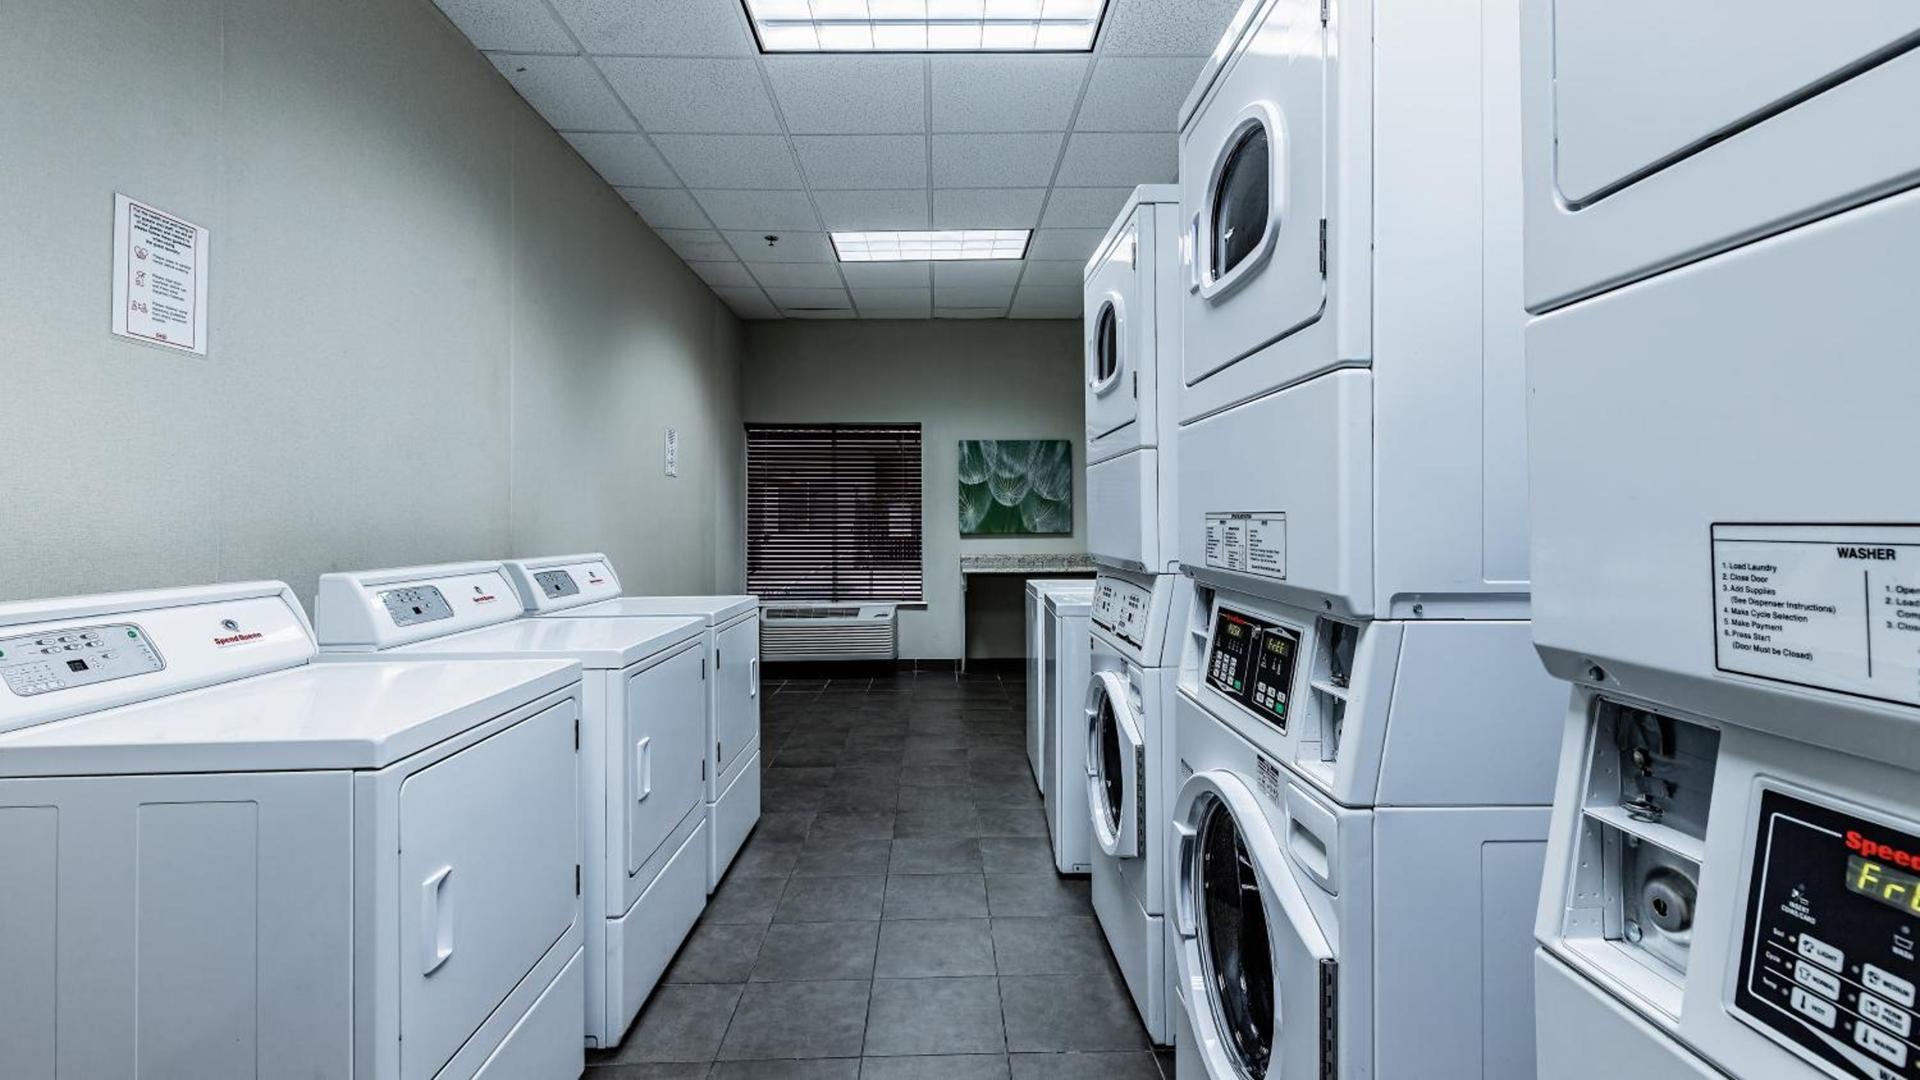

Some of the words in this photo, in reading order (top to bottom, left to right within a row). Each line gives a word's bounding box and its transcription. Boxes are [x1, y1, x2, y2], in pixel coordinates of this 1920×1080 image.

[1837, 547, 1896, 560] WASHER
[1729, 562, 1746, 570] Load
[1747, 563, 1777, 573] Laundry
[1730, 573, 1749, 582] Close
[1750, 574, 1768, 583] Door
[1730, 584, 1744, 593] Add
[1745, 585, 1776, 596] Supplies
[1730, 596, 1746, 605] (See
[1748, 597, 1785, 608] Dispenser
[1786, 600, 1837, 615] Instructions)
[1731, 607, 1749, 616] Make
[1750, 609, 1771, 619] Cycle
[1772, 611, 1808, 623] Selection
[1731, 618, 1750, 628] Make
[1751, 620, 1783, 632] Payment
[1731, 630, 1751, 640] Press
[1753, 633, 1771, 642] Start
[1732, 641, 1751, 651] (Door
[1752, 644, 1771, 654] Must
[1772, 647, 1781, 656] be
[1782, 648, 1813, 661] Closed)
